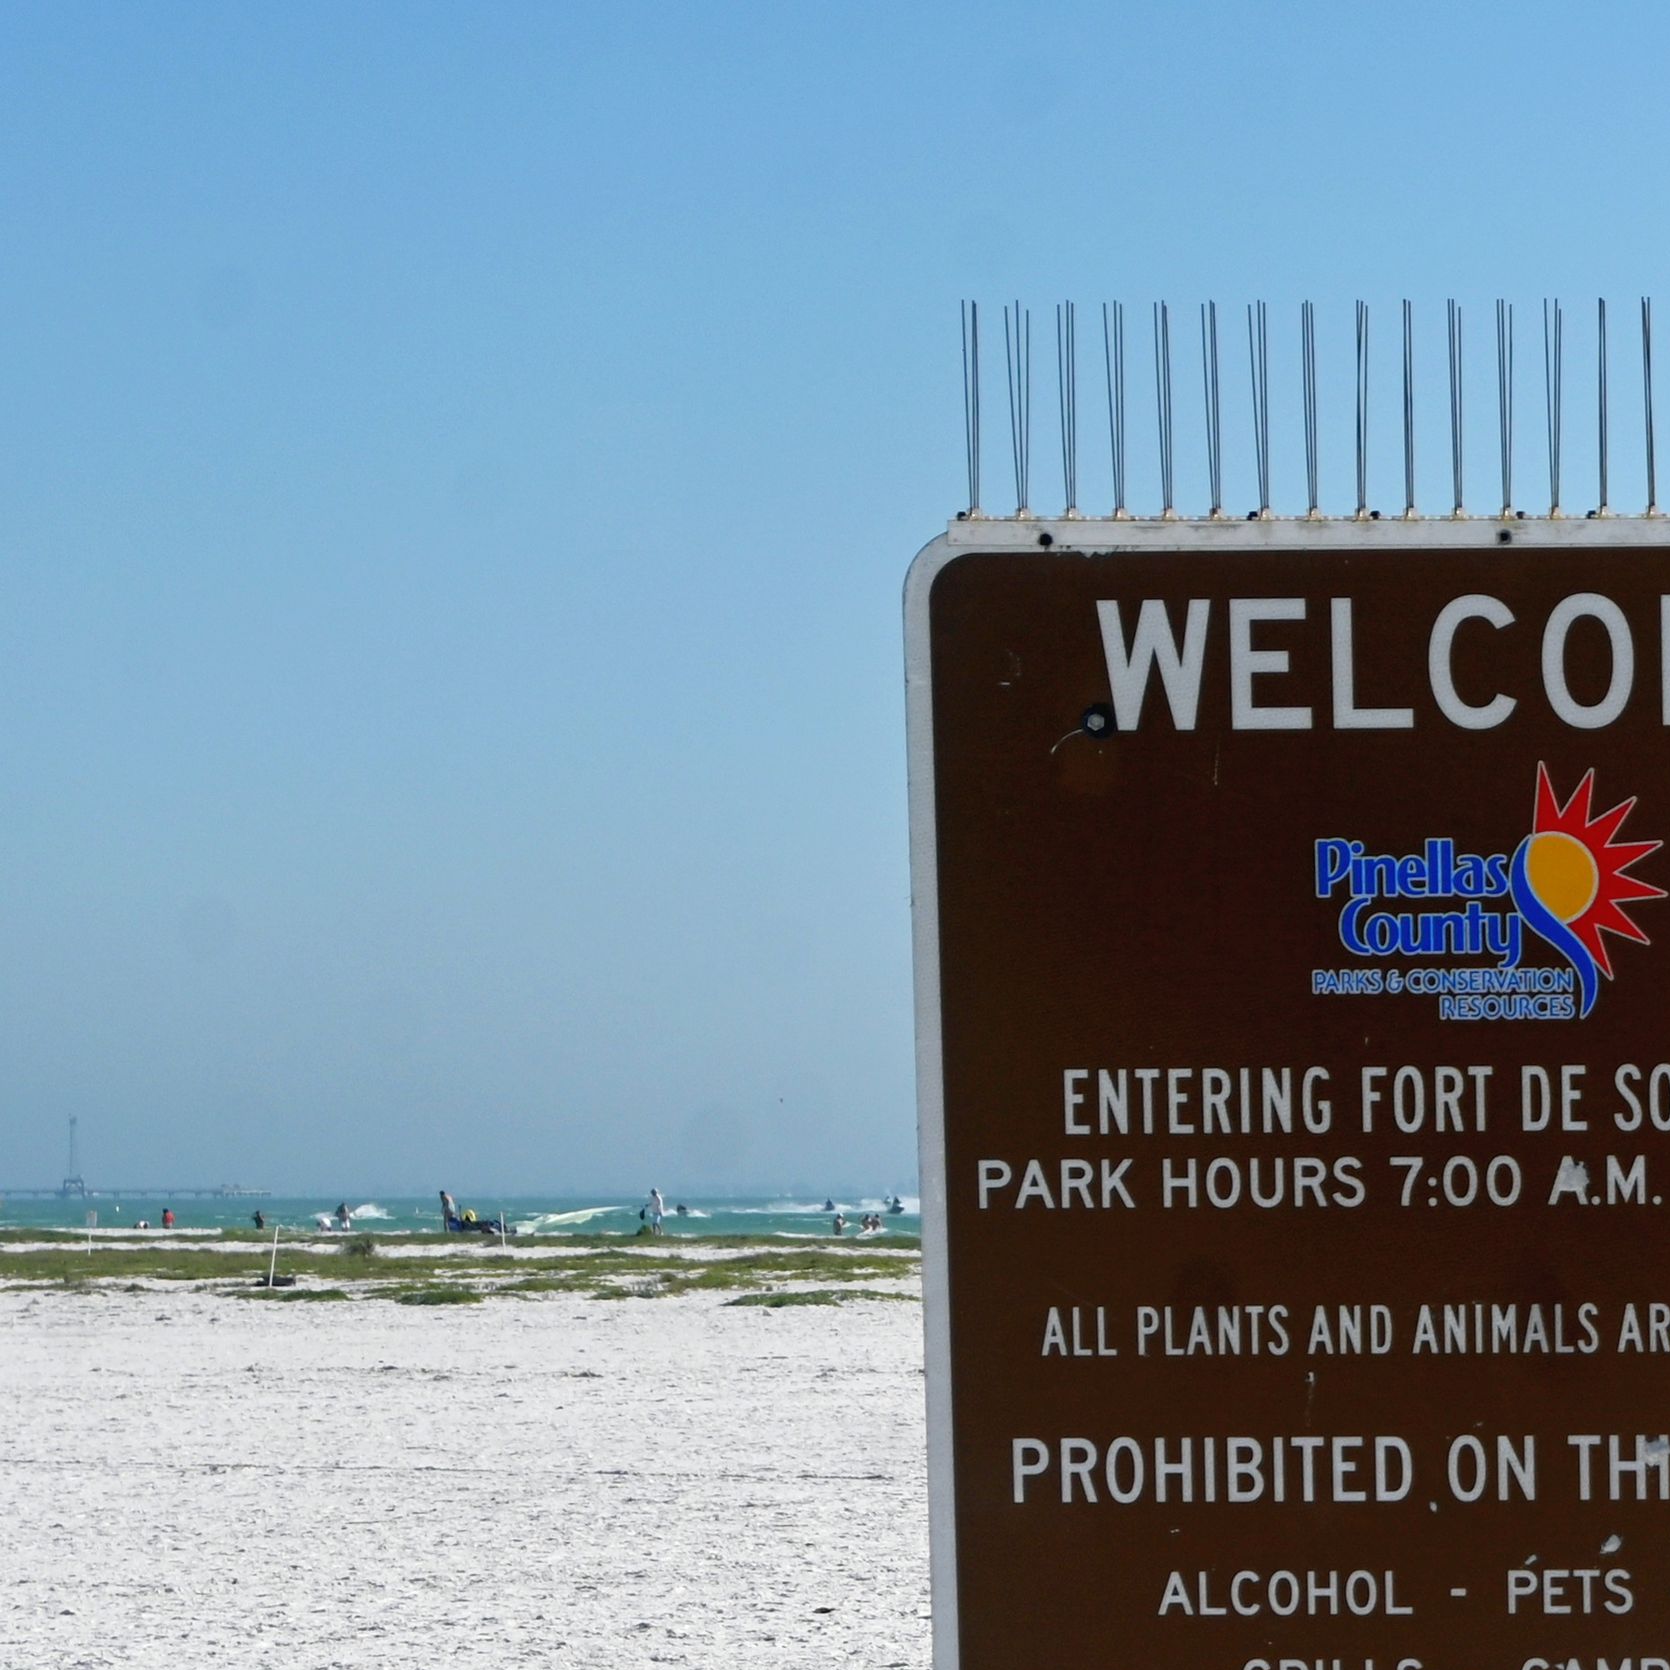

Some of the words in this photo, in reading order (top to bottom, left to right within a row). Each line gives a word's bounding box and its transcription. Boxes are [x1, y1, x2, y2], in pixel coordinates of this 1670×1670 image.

[1315, 838, 1507, 896] Pinellas
[1339, 898, 1523, 968] County
[1313, 970, 1381, 993] PARKS
[1386, 970, 1403, 992] &
[1407, 969, 1573, 993] CONSERVATION
[1440, 996, 1574, 1020] RESOURCES
[1065, 1067, 1331, 1135] ENTERING
[1362, 1065, 1493, 1132] FORT
[1521, 1064, 1588, 1131] DE
[979, 1158, 1134, 1209] PARK
[1163, 1157, 1365, 1208] HOURS
[1390, 1155, 1521, 1207] 7:00
[1548, 1155, 1662, 1205] A.M.
[1042, 1306, 1117, 1356] ALL
[1137, 1305, 1289, 1356] PLANTS
[1308, 1304, 1392, 1355] AND
[1412, 1303, 1599, 1354] ANIMALS
[1012, 1436, 1413, 1504] PROHIBITED
[1448, 1434, 1535, 1501] ON
[1158, 1570, 1413, 1616] ALCOHOL
[1507, 1569, 1633, 1614] PETS
